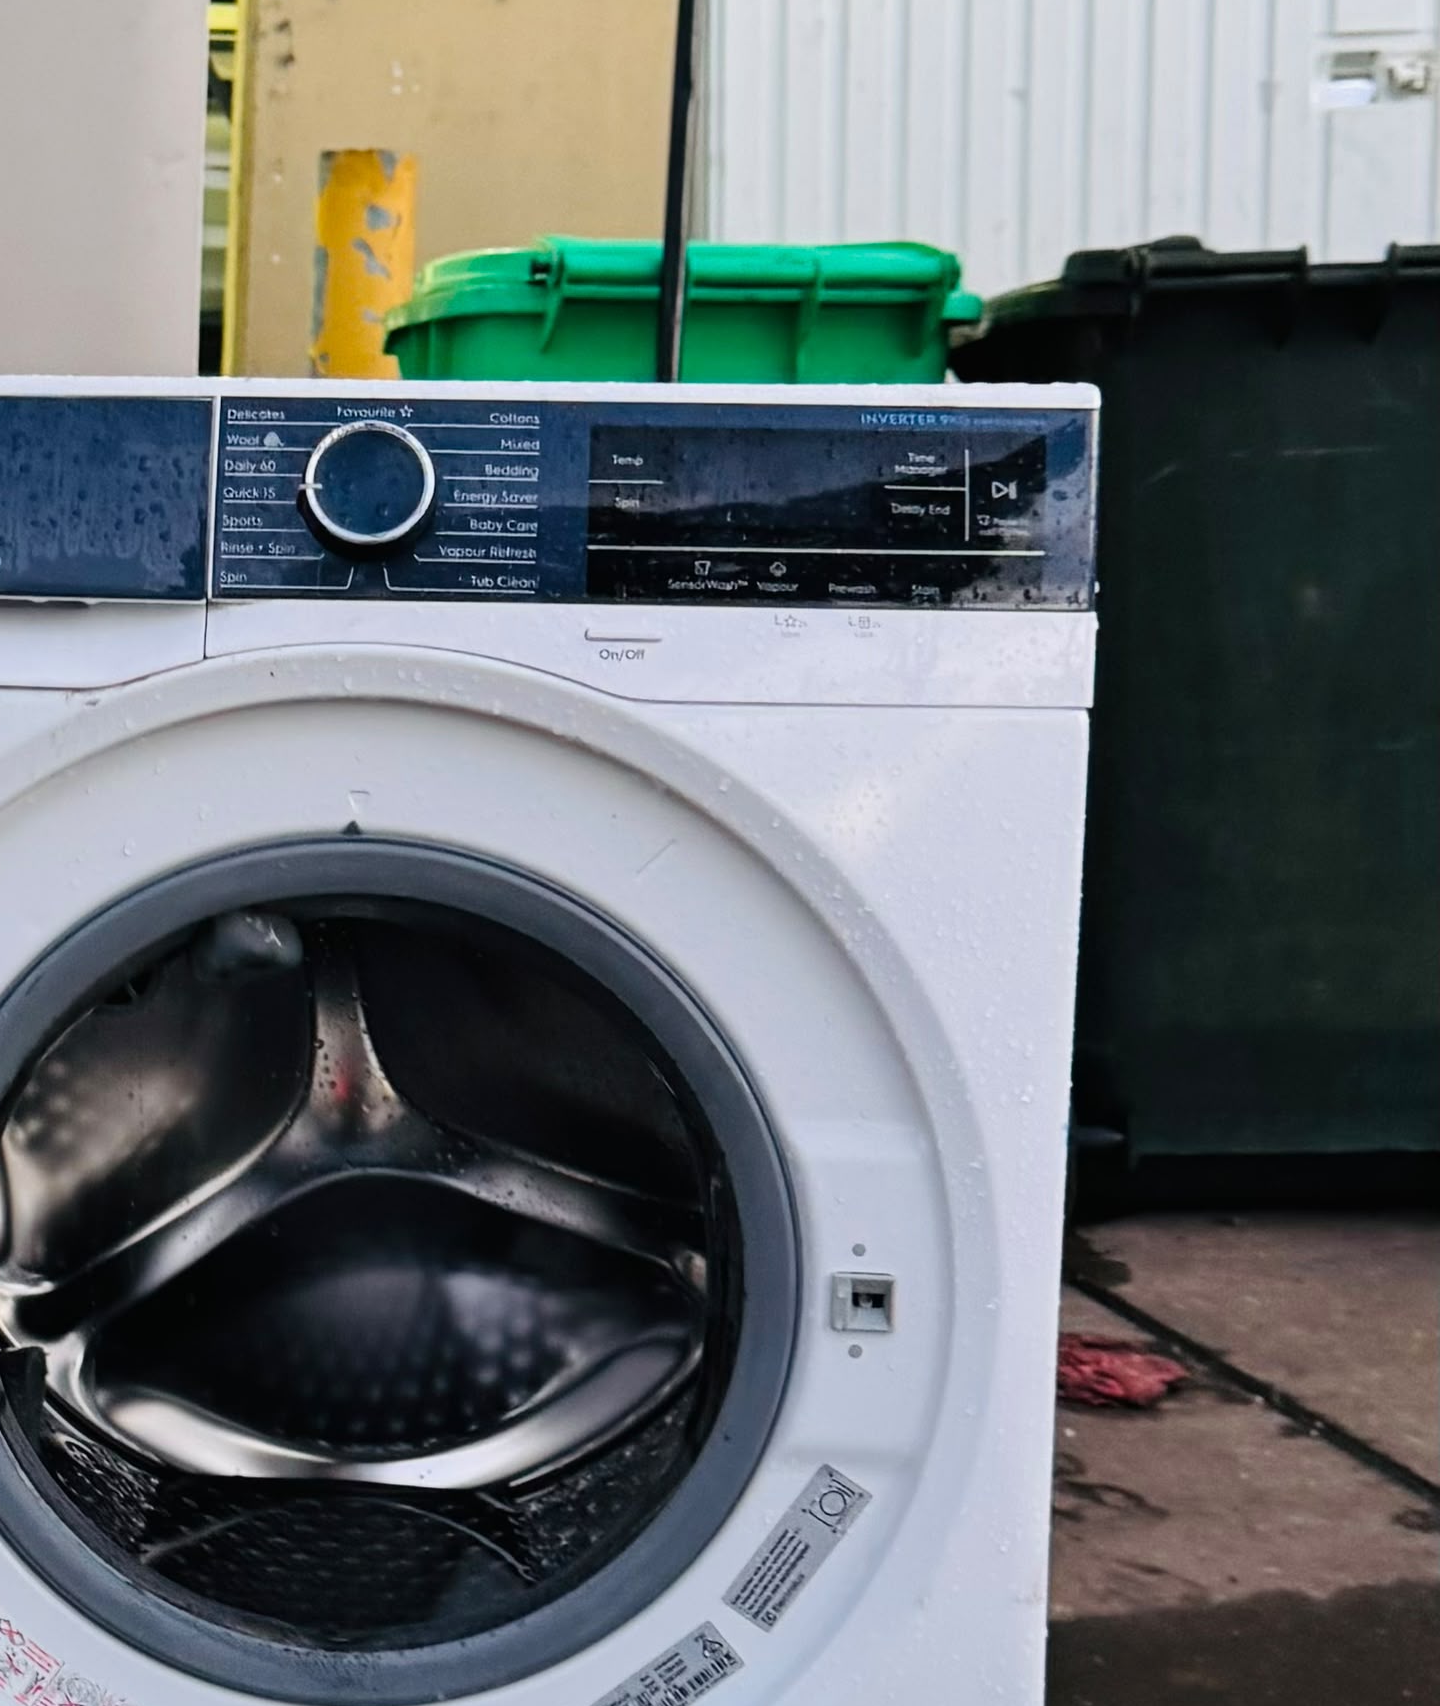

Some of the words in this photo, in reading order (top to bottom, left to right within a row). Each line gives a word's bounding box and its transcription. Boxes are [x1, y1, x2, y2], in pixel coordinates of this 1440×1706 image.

[227, 408, 285, 420] Delicates
[337, 405, 396, 418] Favourite
[489, 412, 540, 425] Cottons
[860, 412, 937, 426] INVERTER
[226, 433, 260, 446] Wool
[500, 438, 540, 451] Mixed
[611, 453, 644, 468] Temp
[907, 452, 936, 463] Time
[224, 459, 256, 473] Daily
[259, 460, 277, 472] 60
[484, 463, 540, 480] Bedding
[894, 464, 948, 477] Manager
[223, 486, 260, 499] Quick
[263, 487, 277, 499] 15
[453, 489, 498, 505] Energy
[500, 490, 539, 503] Saver
[890, 502, 926, 517] Delay
[928, 503, 951, 515] End
[222, 514, 264, 529] Sports
[469, 518, 503, 533] Baby
[506, 519, 539, 532] Care
[220, 541, 254, 553] Rinse
[267, 541, 296, 556] Spin
[438, 544, 487, 561] Vapour
[489, 545, 538, 559] Refresh
[219, 570, 248, 584] Spin
[471, 574, 494, 588] Tub
[496, 575, 537, 589] Clean
[598, 647, 646, 662] On/Off
